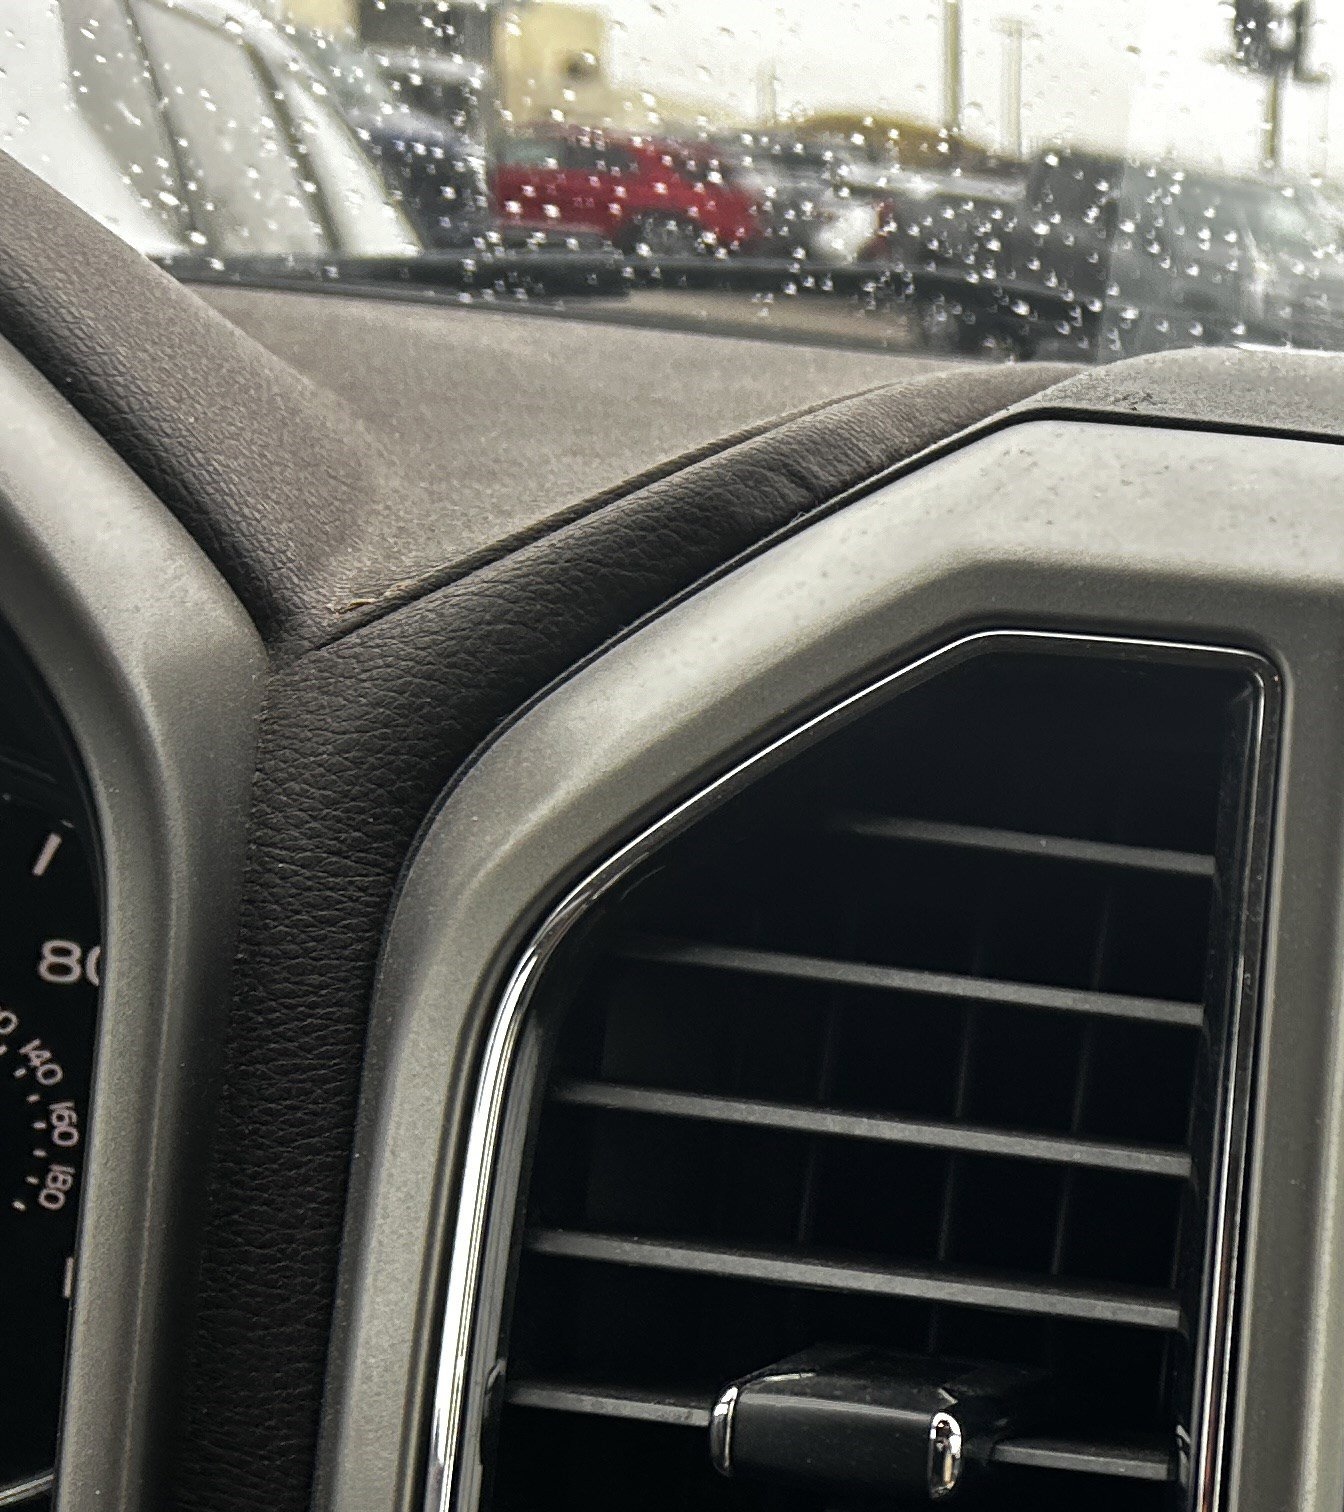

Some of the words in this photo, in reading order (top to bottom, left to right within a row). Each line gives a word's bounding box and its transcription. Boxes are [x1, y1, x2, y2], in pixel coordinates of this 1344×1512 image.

[37, 938, 100, 984] 8
[18, 1038, 64, 1086] 140
[48, 1101, 80, 1147] 160
[37, 1164, 76, 1211] 180
